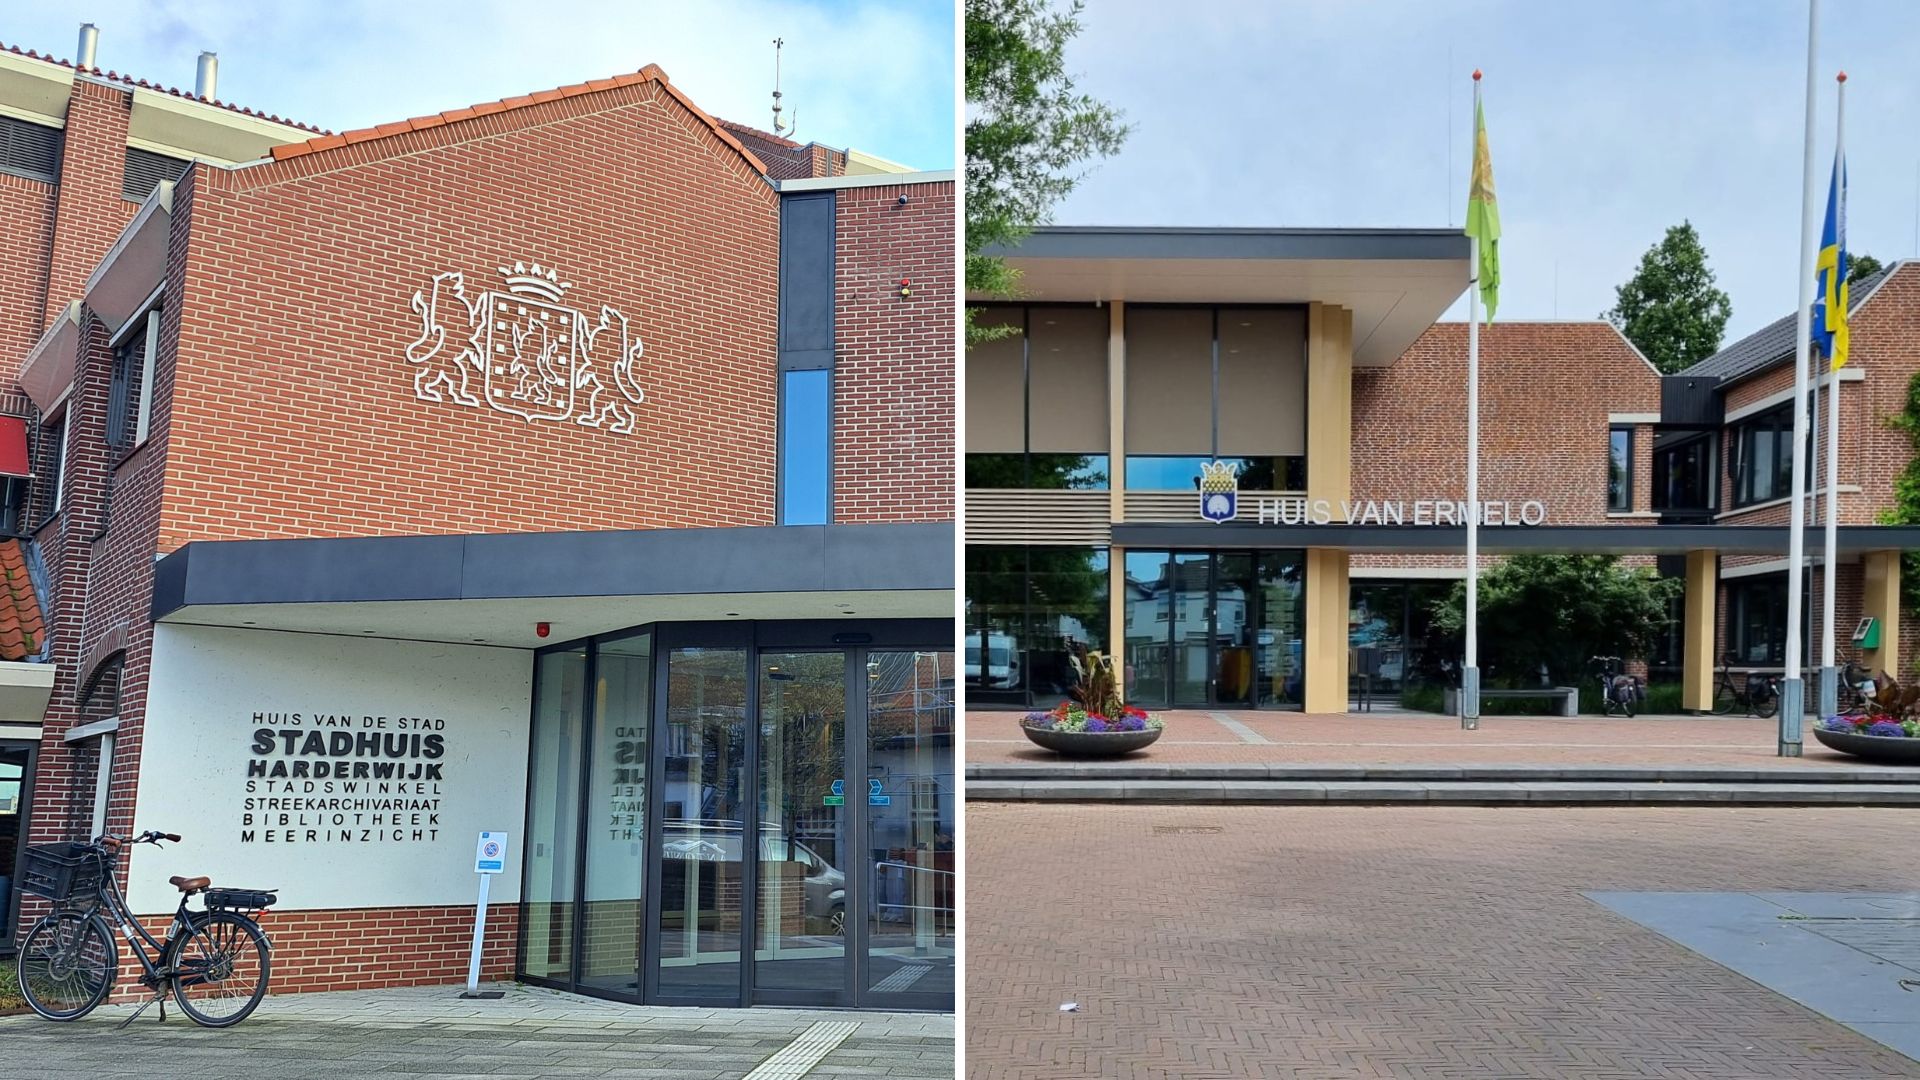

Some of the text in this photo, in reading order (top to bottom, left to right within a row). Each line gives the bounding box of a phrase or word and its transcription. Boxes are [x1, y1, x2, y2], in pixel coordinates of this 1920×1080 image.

[1259, 500, 1545, 526] HUIS VAN ERMELO
[252, 712, 445, 731] HUIS VAN DE STAD
[251, 728, 445, 759] STADHUIS
[247, 759, 444, 781] HARDERWIJK
[245, 780, 442, 795] STADSWINKEL
[244, 798, 441, 811] STREEKARCHIVARIAAT
[243, 813, 440, 826] BIBLIOTHEEK
[241, 829, 439, 843] MEERINZICHT
